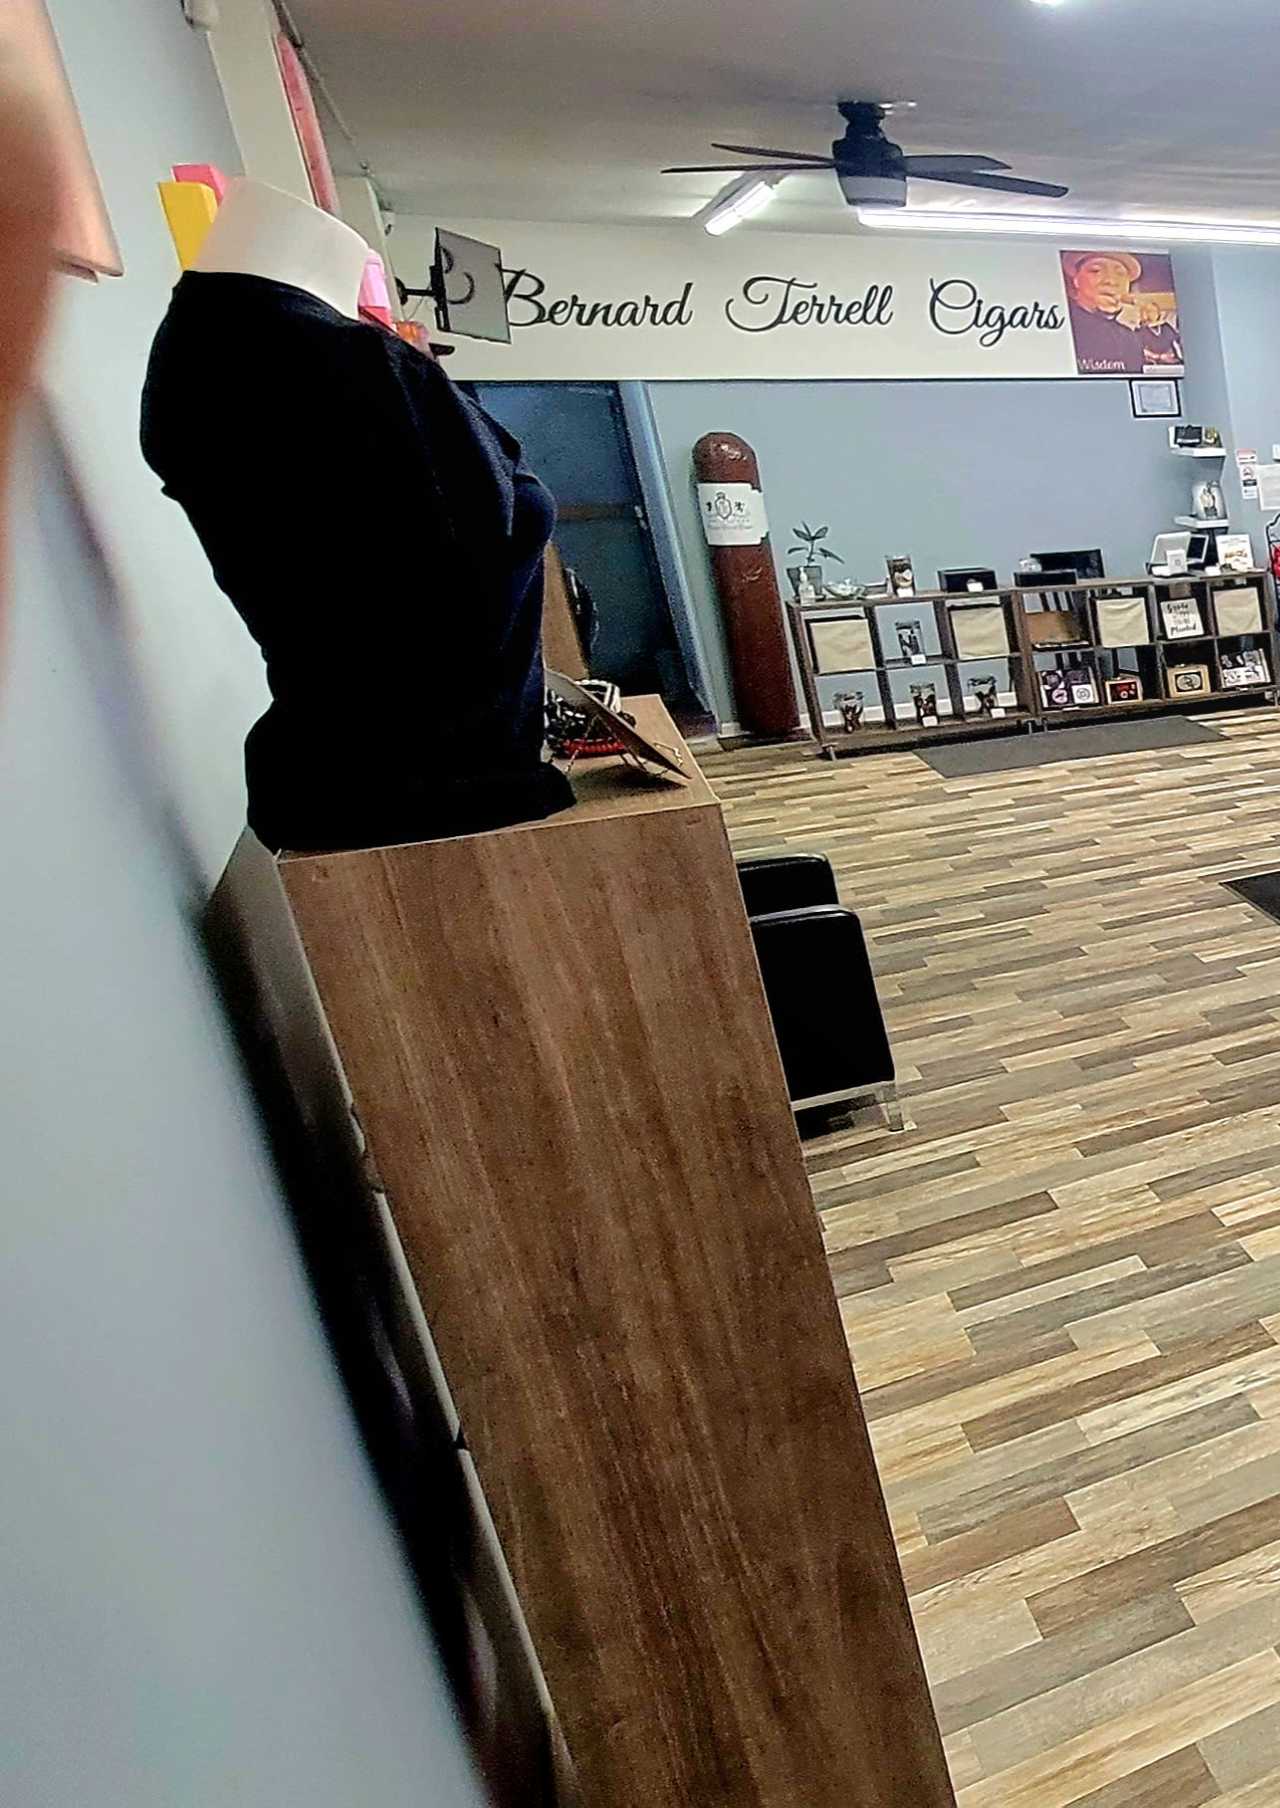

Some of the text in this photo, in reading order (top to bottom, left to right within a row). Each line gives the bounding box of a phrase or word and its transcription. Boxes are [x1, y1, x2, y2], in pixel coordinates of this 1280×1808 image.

[496, 264, 1067, 348] Bernard Terrell Cigars
